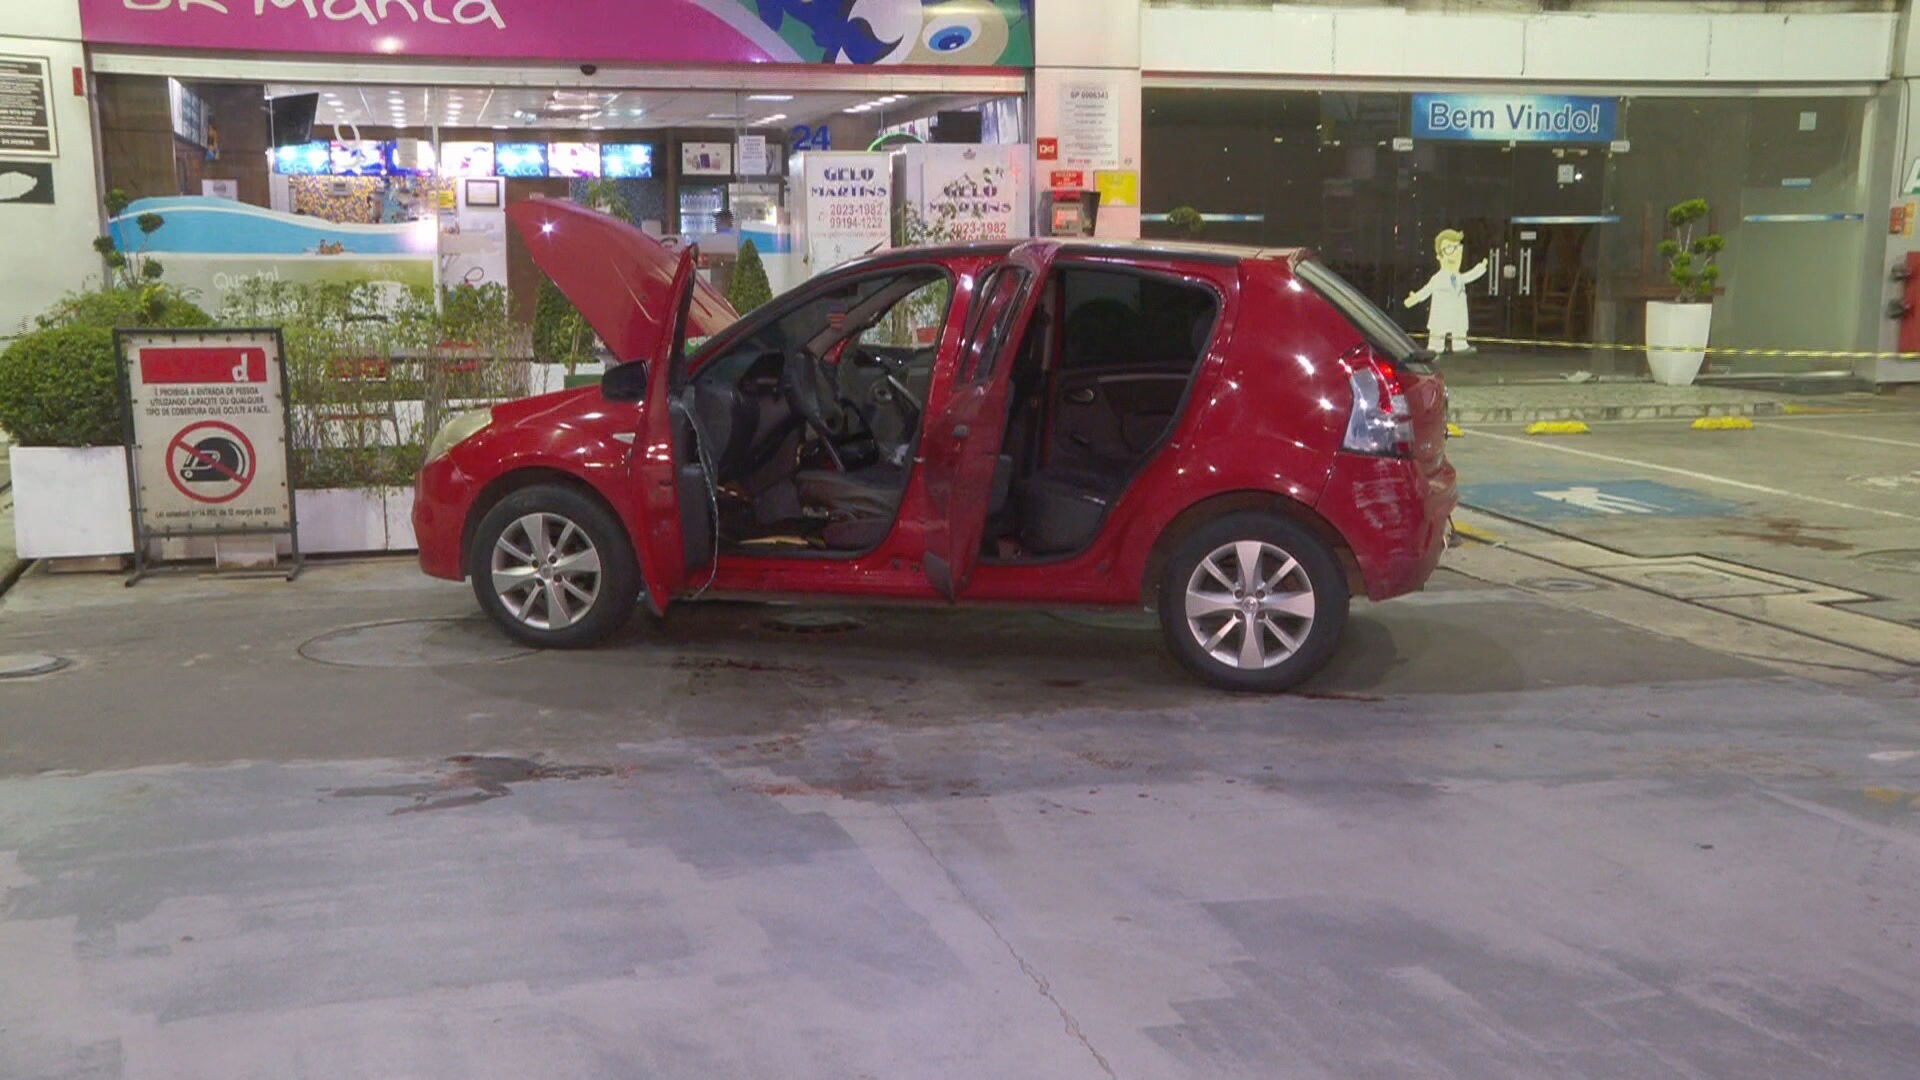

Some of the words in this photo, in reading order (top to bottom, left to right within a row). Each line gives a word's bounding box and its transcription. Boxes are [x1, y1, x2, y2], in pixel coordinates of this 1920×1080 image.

[1429, 102, 1495, 131] Bem
[1505, 103, 1600, 133] Vindo!
[792, 124, 831, 151] 24
[824, 167, 875, 181] GELO
[811, 187, 887, 198] MARTINS
[830, 203, 883, 216] 2023-1982
[830, 217, 883, 230] 99194-1222
[951, 222, 1007, 234] 2023-1982
[219, 397, 229, 405] OU
[146, 408, 160, 417] TIPO
[171, 407, 207, 416] COBERTURA
[208, 407, 221, 416] QUE
